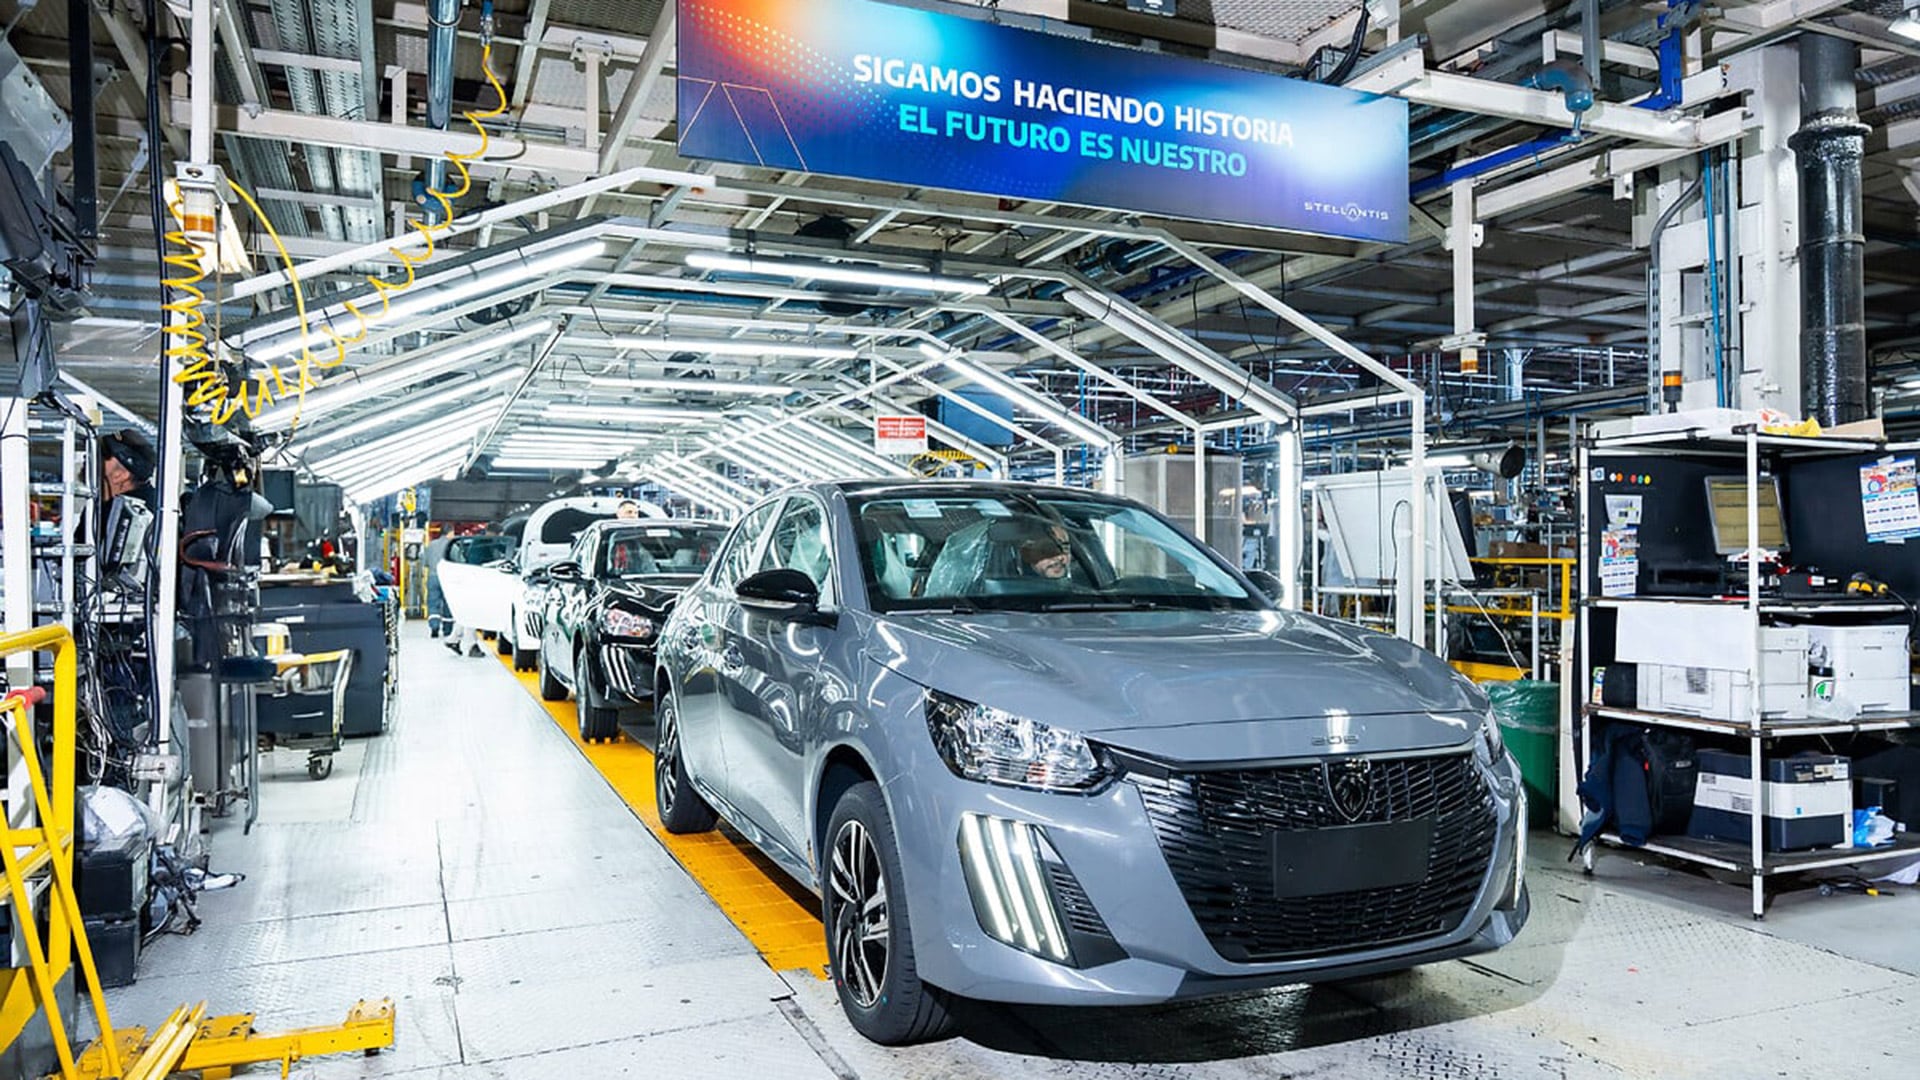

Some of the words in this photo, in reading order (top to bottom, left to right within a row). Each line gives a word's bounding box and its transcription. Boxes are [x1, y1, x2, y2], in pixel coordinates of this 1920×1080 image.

[853, 54, 1001, 102] SIGAMOS
[1013, 80, 1164, 128] HACIENDO
[1174, 106, 1294, 148] HISTORIA
[898, 103, 937, 136] EL
[945, 111, 1071, 153] FUTURO
[1080, 130, 1114, 160] ES
[1121, 137, 1247, 177] NUESTRO
[1304, 201, 1389, 222] STELLANTIS
